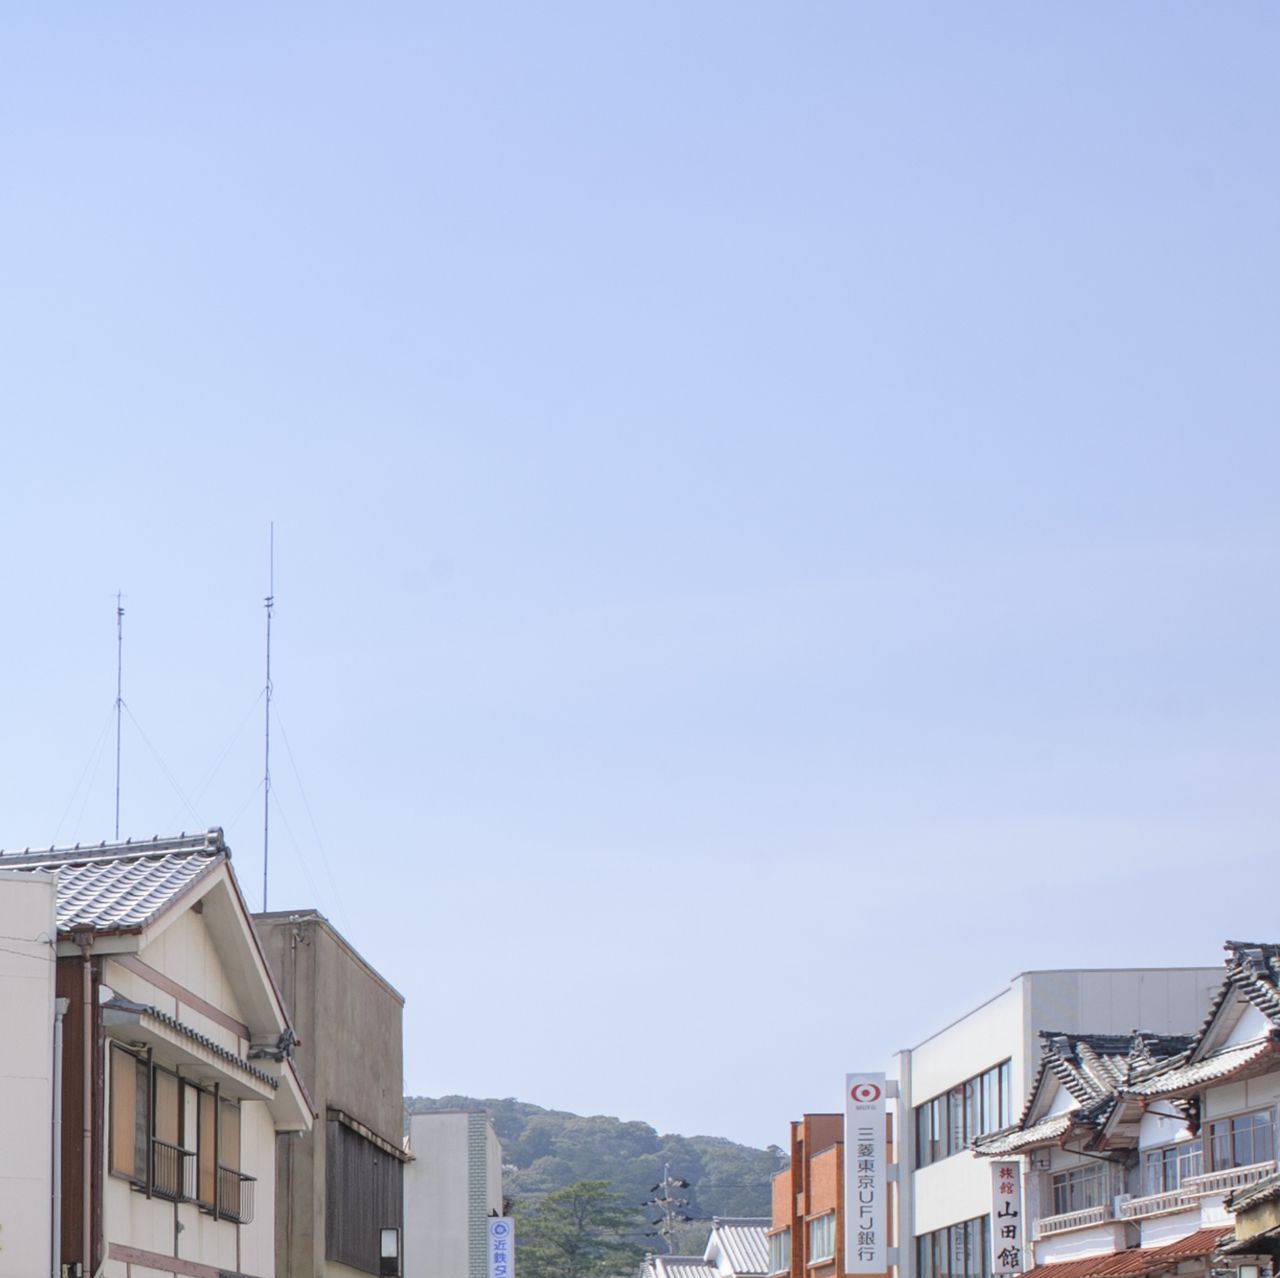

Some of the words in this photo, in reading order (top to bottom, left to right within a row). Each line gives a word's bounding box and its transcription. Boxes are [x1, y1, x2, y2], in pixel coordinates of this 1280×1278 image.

[857, 1126, 875, 1262] 三菱東京UFJ銀行
[999, 1167, 1015, 1195] 旅館
[997, 1200, 1021, 1269] 山田館
